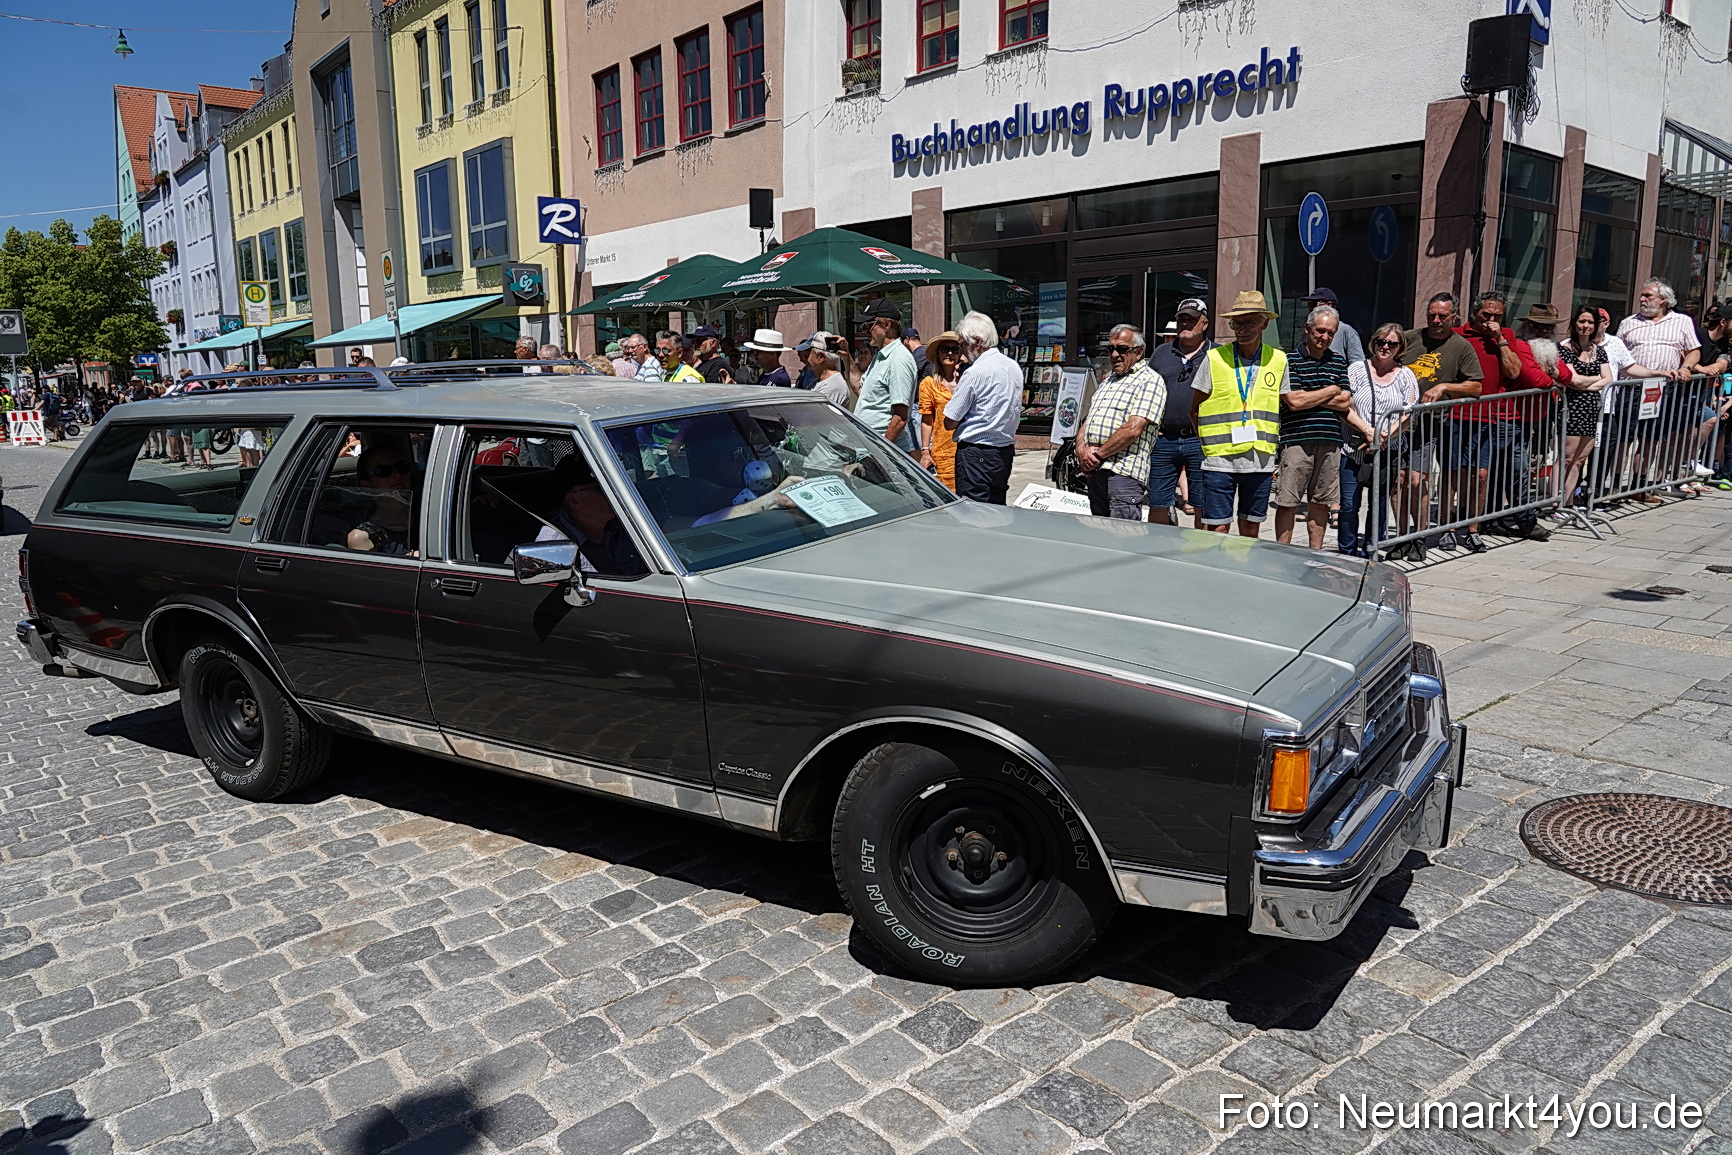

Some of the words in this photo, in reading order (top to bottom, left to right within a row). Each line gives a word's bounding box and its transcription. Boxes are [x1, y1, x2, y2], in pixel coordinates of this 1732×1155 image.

[891, 100, 1092, 164] Buchhandlung
[1104, 46, 1303, 121] Rupprecht
[600, 254, 611, 263] Markt
[611, 252, 617, 261] 15
[519, 274, 533, 293] G2
[250, 288, 261, 300] H
[823, 484, 845, 497] 190
[188, 642, 239, 664] NEXEN
[717, 762, 746, 775] Caprice
[745, 767, 772, 781] Classic
[1001, 760, 1090, 870] NEXEN
[861, 838, 876, 874] HT
[865, 884, 966, 968] ROADIAN
